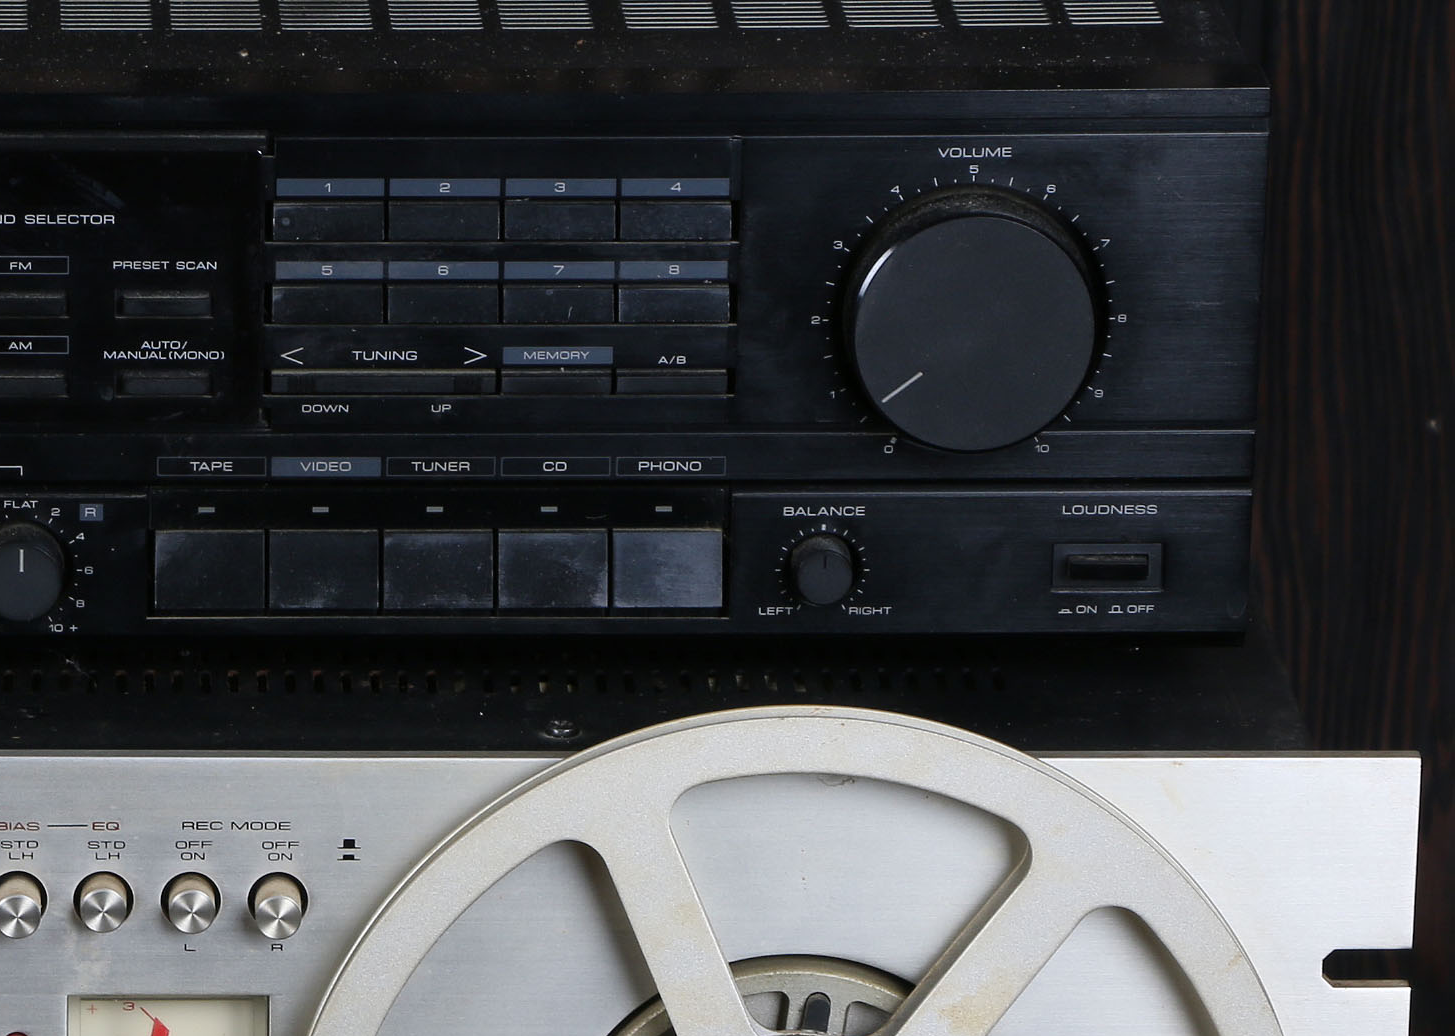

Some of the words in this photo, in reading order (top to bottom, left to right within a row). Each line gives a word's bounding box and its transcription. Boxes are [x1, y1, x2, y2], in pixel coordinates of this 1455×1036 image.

[938, 146, 1013, 159] VOLUME
[969, 164, 979, 174] 5
[324, 182, 331, 193] 1
[439, 182, 451, 193] 2
[553, 182, 566, 193] 3
[669, 181, 682, 193] 4
[24, 214, 115, 225] SELECTOR
[9, 260, 32, 271] FM
[112, 260, 170, 270] PRESET
[175, 260, 218, 271] SCAN
[320, 264, 334, 276] 5
[437, 265, 450, 276] 6
[552, 264, 565, 276] 7
[668, 264, 680, 276] 8
[8, 341, 33, 350] AM
[140, 340, 188, 350] AUTO/
[351, 350, 418, 361] TUNING
[523, 350, 590, 361] MEMORY
[657, 355, 687, 365] A/B
[301, 404, 350, 413] DOWN
[430, 403, 452, 413] UP
[883, 444, 894, 454] 0
[1035, 444, 1050, 453] 10
[189, 460, 233, 472] TAPE
[299, 461, 352, 472] VIDEO
[411, 461, 470, 472] TUNER
[542, 459, 570, 472] CD
[636, 460, 703, 473] PHONO
[3, 500, 39, 509] FLAT
[1062, 504, 1158, 515] LOUDNESS
[84, 507, 97, 518] R
[783, 505, 866, 517] BALANCE
[758, 606, 794, 616] LEFT
[848, 606, 893, 616] RIGHT
[1075, 604, 1098, 614] ON
[1126, 604, 1155, 614] OFF
[91, 821, 120, 832] EQ
[181, 821, 223, 831] REC
[230, 821, 291, 831] MODE
[0, 840, 39, 850] STD
[87, 840, 126, 850] STD
[175, 840, 213, 850] OFF
[261, 840, 300, 850] OFF
[8, 851, 34, 861] LH
[95, 851, 121, 861] LH
[180, 851, 206, 861] ON
[267, 852, 293, 862] ON
[184, 943, 197, 952] L
[270, 943, 284, 952] R
